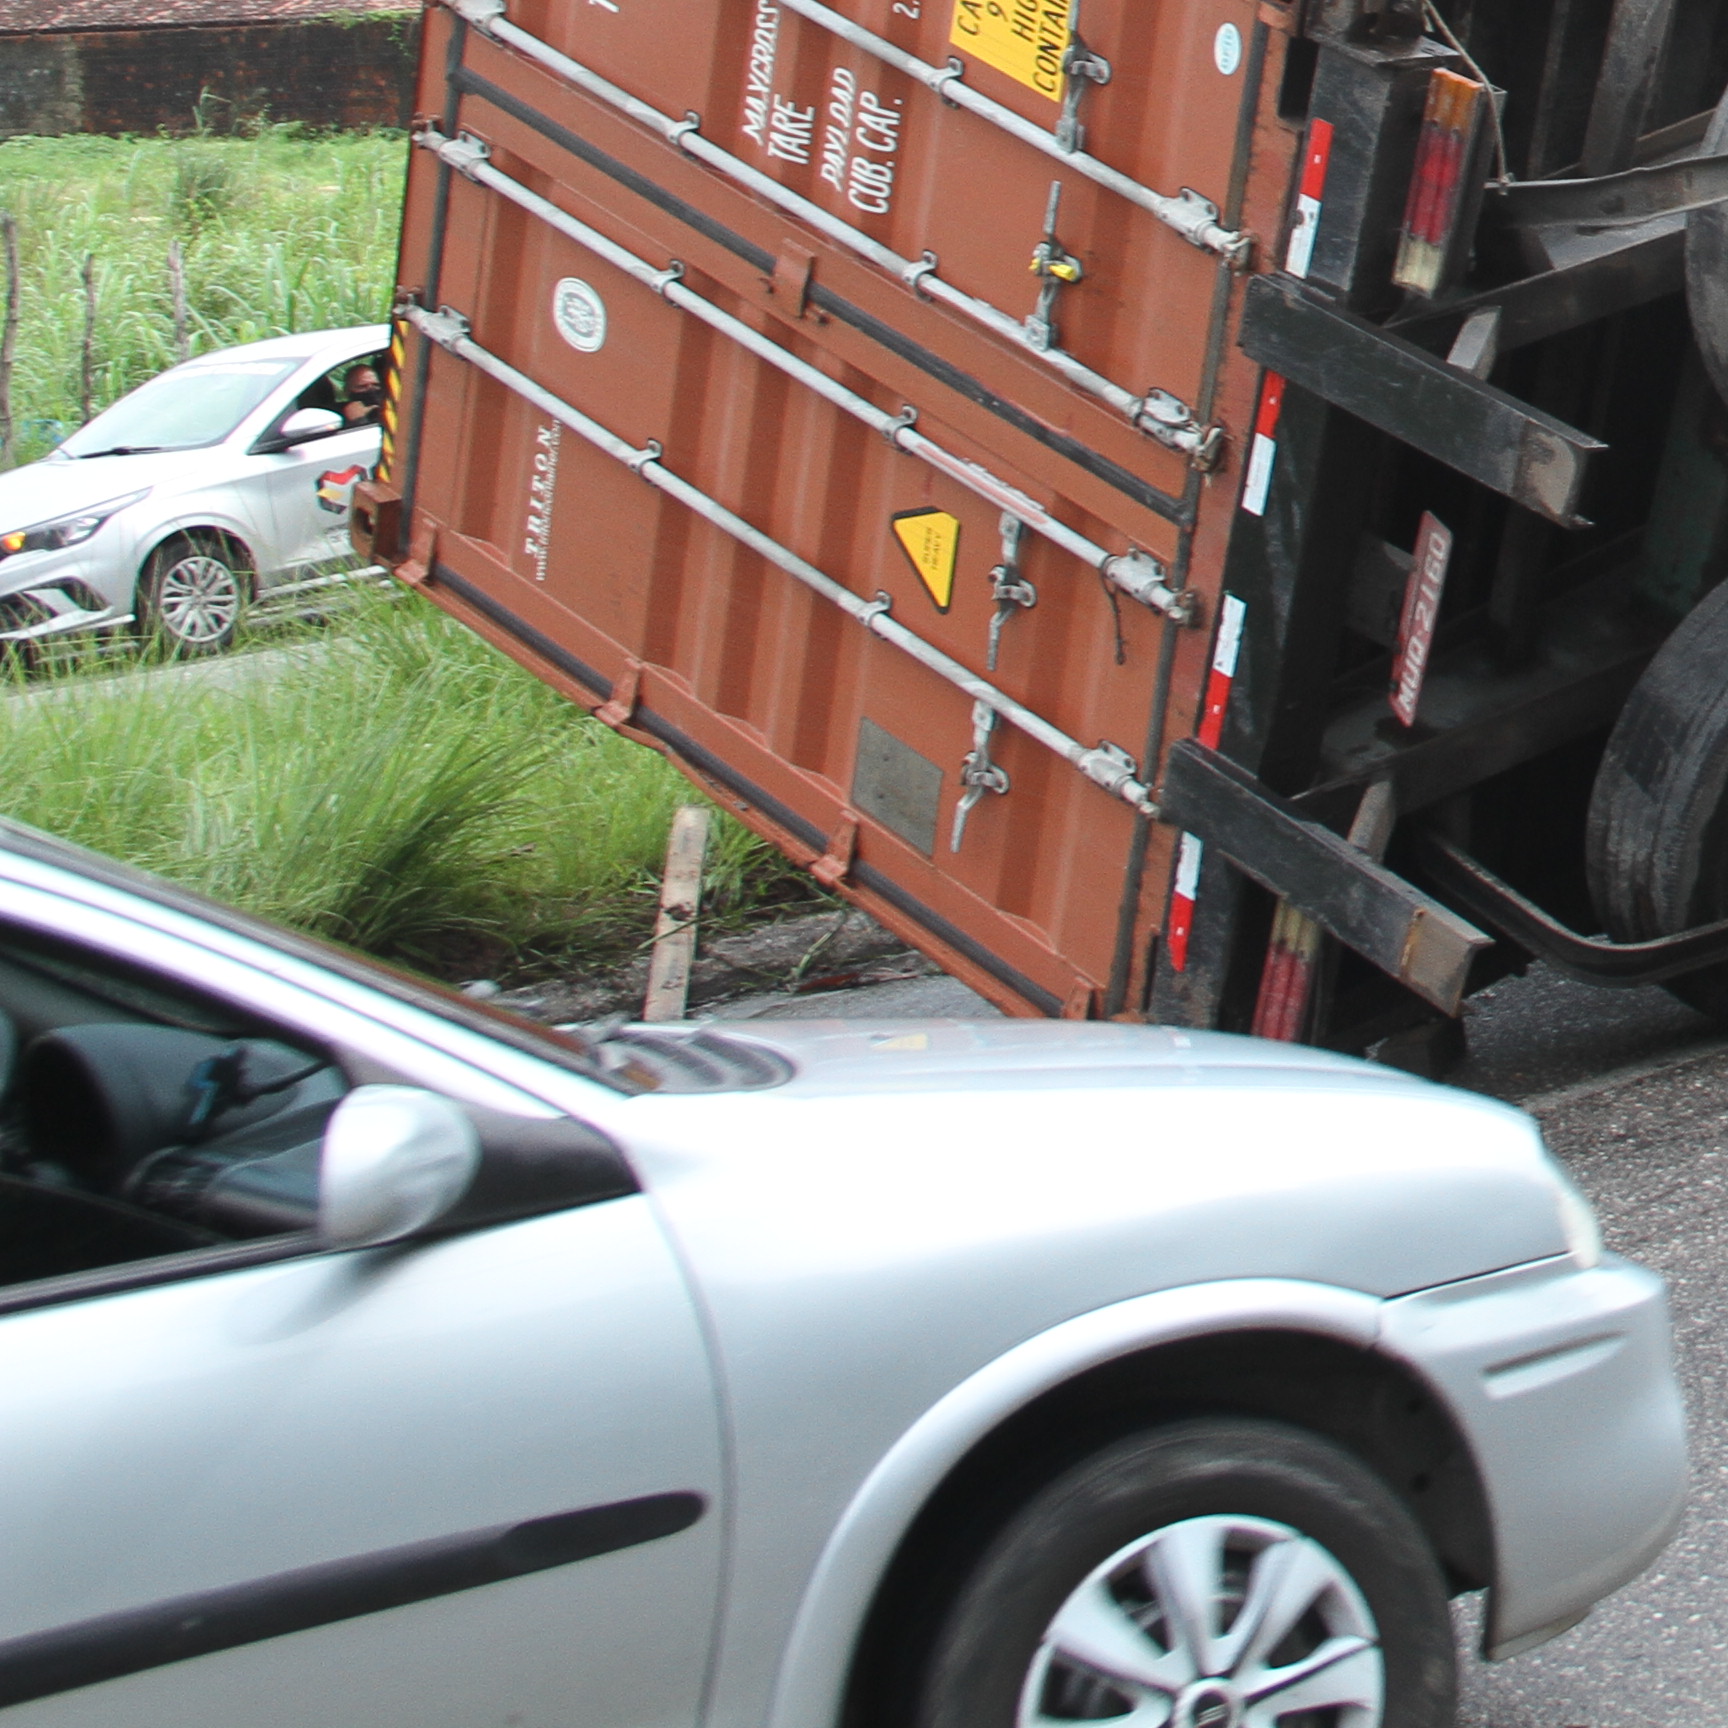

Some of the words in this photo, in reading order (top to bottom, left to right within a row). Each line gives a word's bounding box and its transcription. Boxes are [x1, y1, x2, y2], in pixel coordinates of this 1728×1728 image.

[767, 93, 816, 165] TARE
[820, 67, 856, 192] PAYLOAD
[855, 90, 903, 152] CAP.
[848, 156, 895, 214] CUB.
[524, 424, 554, 559] TRITON
